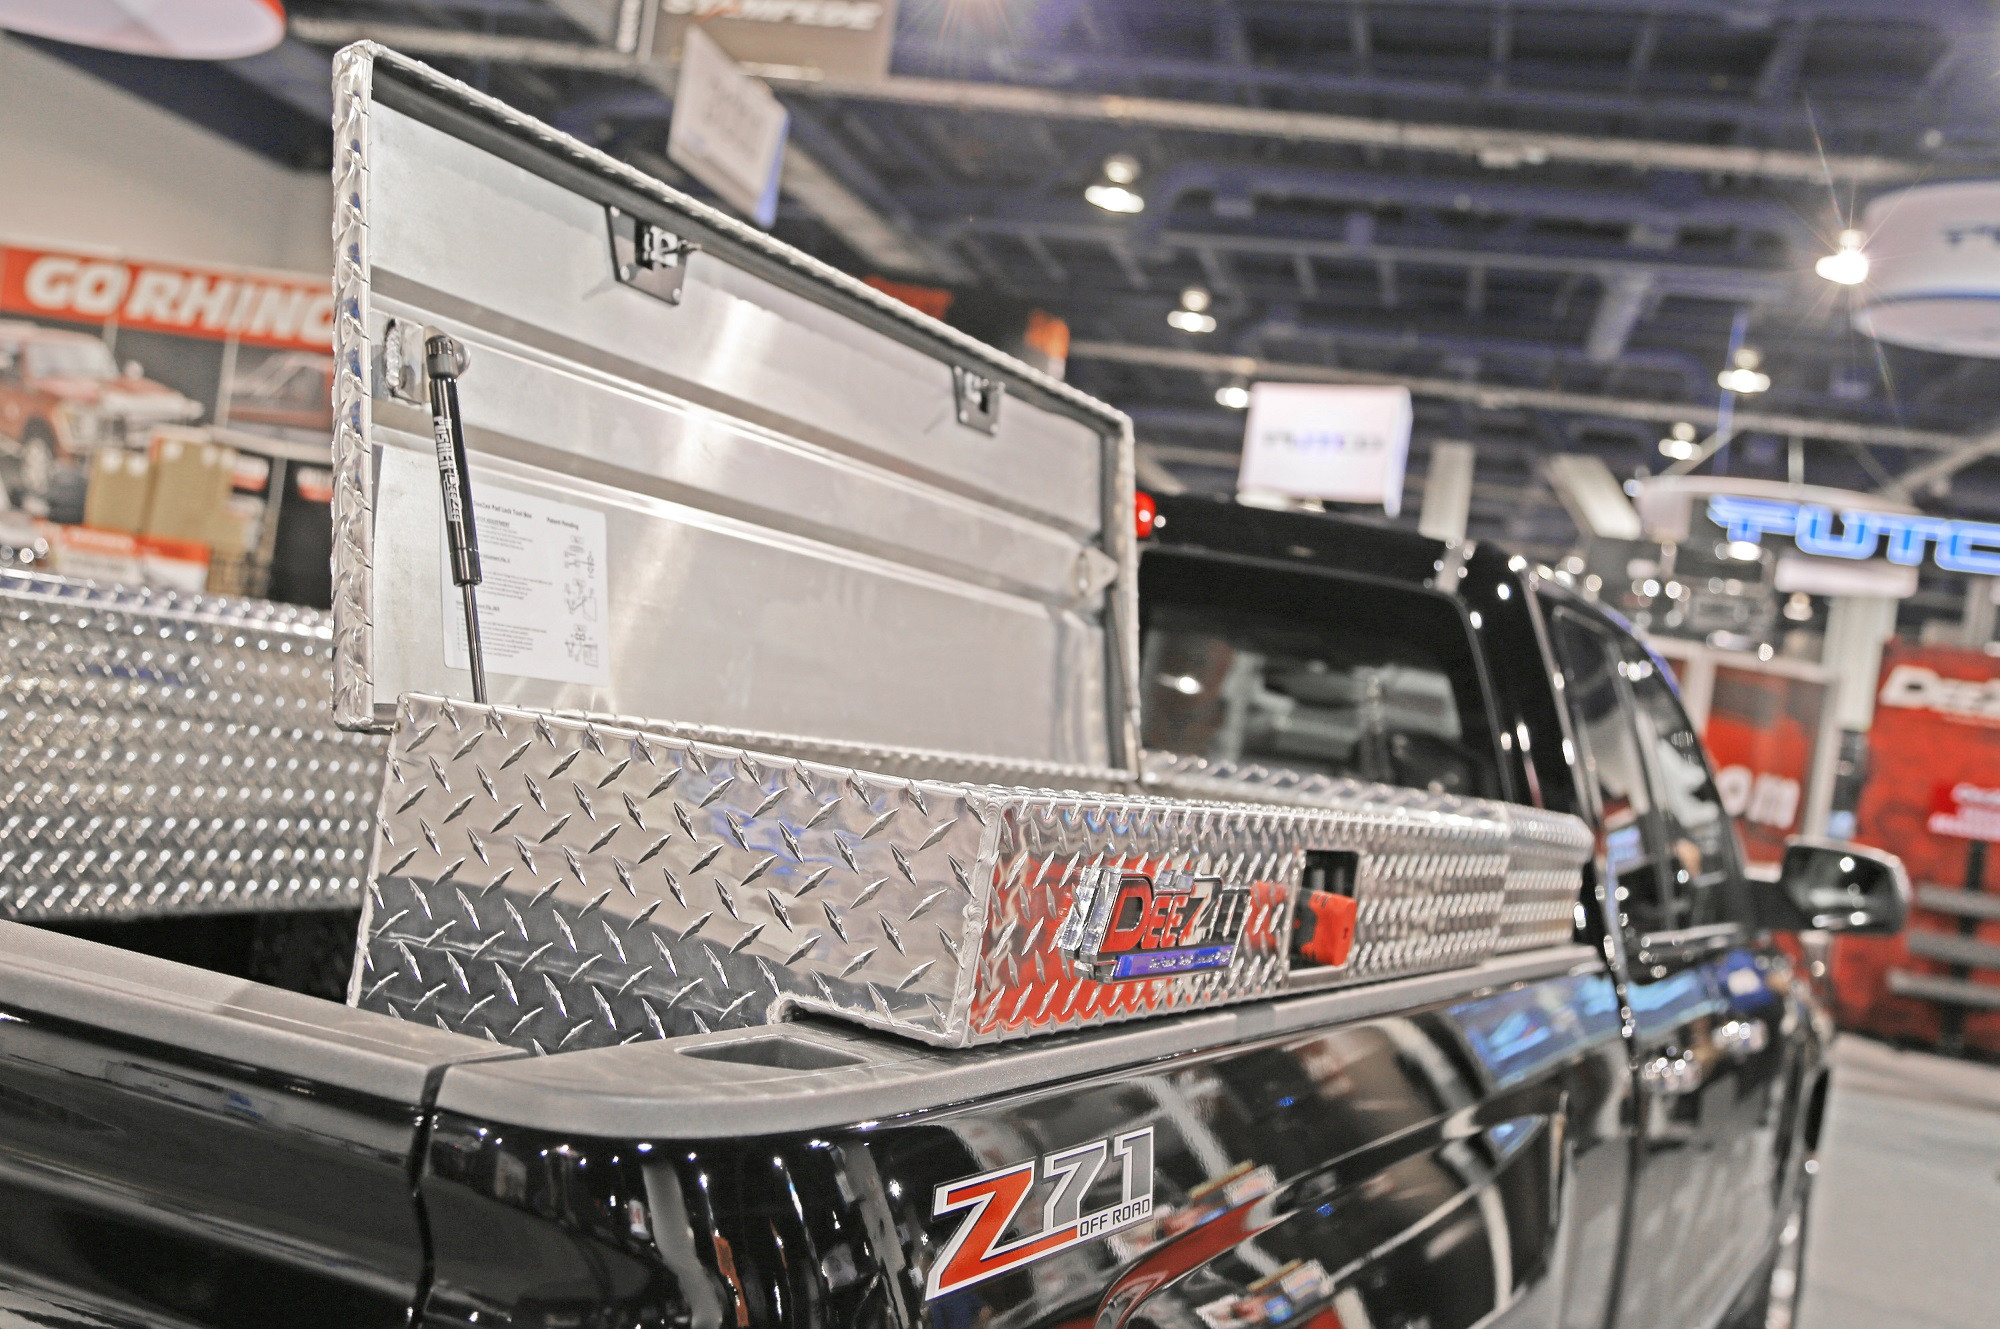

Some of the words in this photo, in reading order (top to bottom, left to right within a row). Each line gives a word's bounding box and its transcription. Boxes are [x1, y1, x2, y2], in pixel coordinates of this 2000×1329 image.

[24, 256, 131, 315] GO
[925, 1126, 1154, 1301] Z71
[1079, 1213, 1108, 1237] OFF
[1112, 1198, 1150, 1225] ROAD
